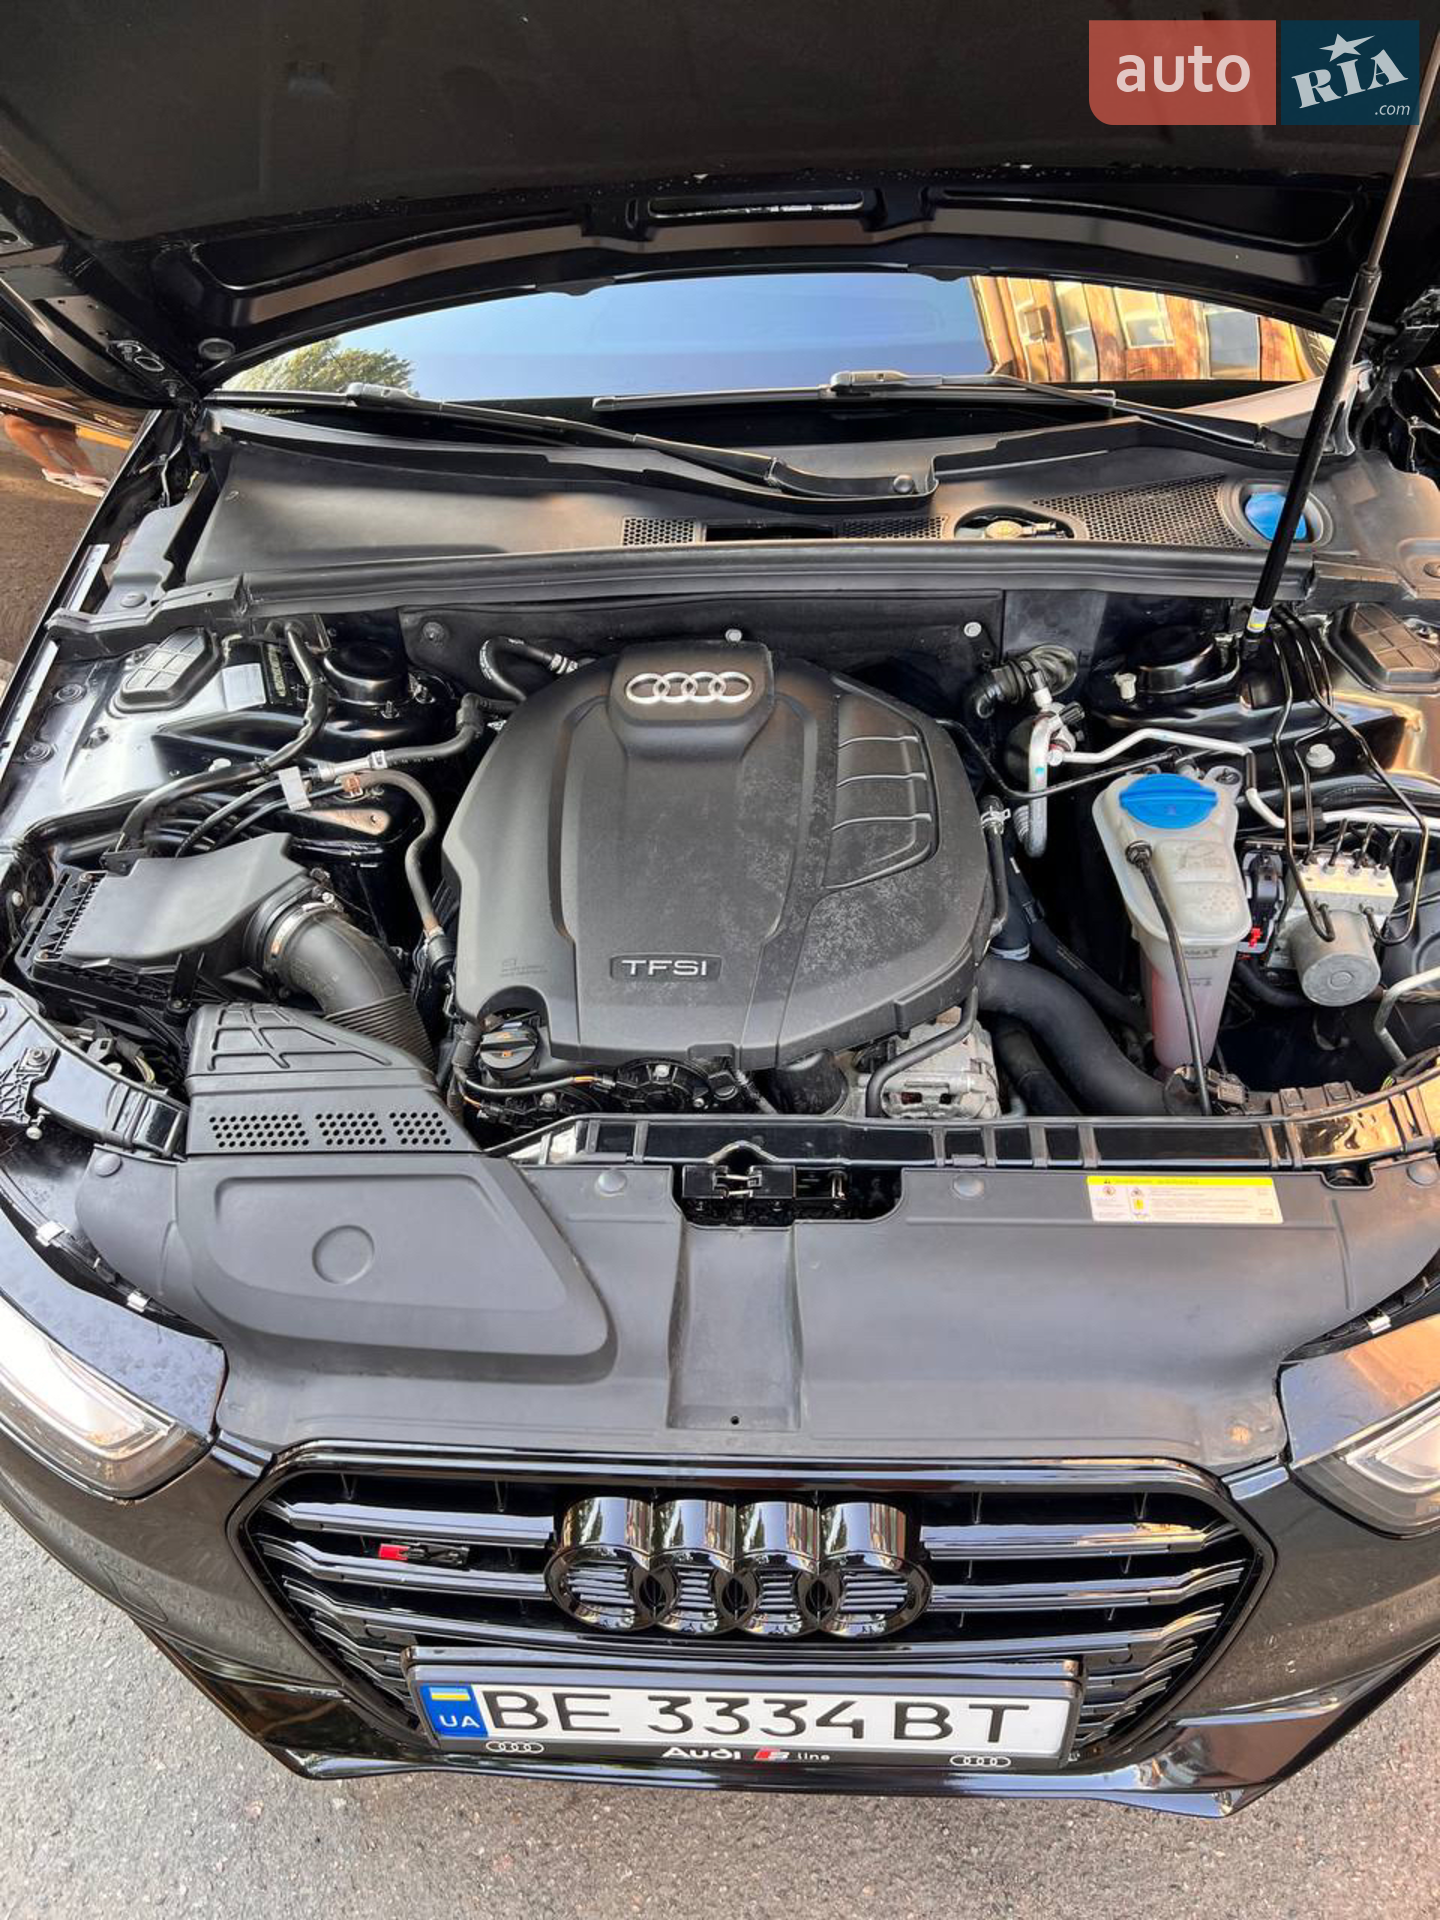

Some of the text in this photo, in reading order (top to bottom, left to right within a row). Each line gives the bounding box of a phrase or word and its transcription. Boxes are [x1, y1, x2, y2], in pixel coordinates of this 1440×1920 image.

[621, 959, 707, 976] TFSI
[440, 1714, 480, 1728] UA
[481, 1690, 1030, 1743] BE 3334 BT
[661, 1746, 742, 1760] Audi
[797, 1751, 831, 1761] line
